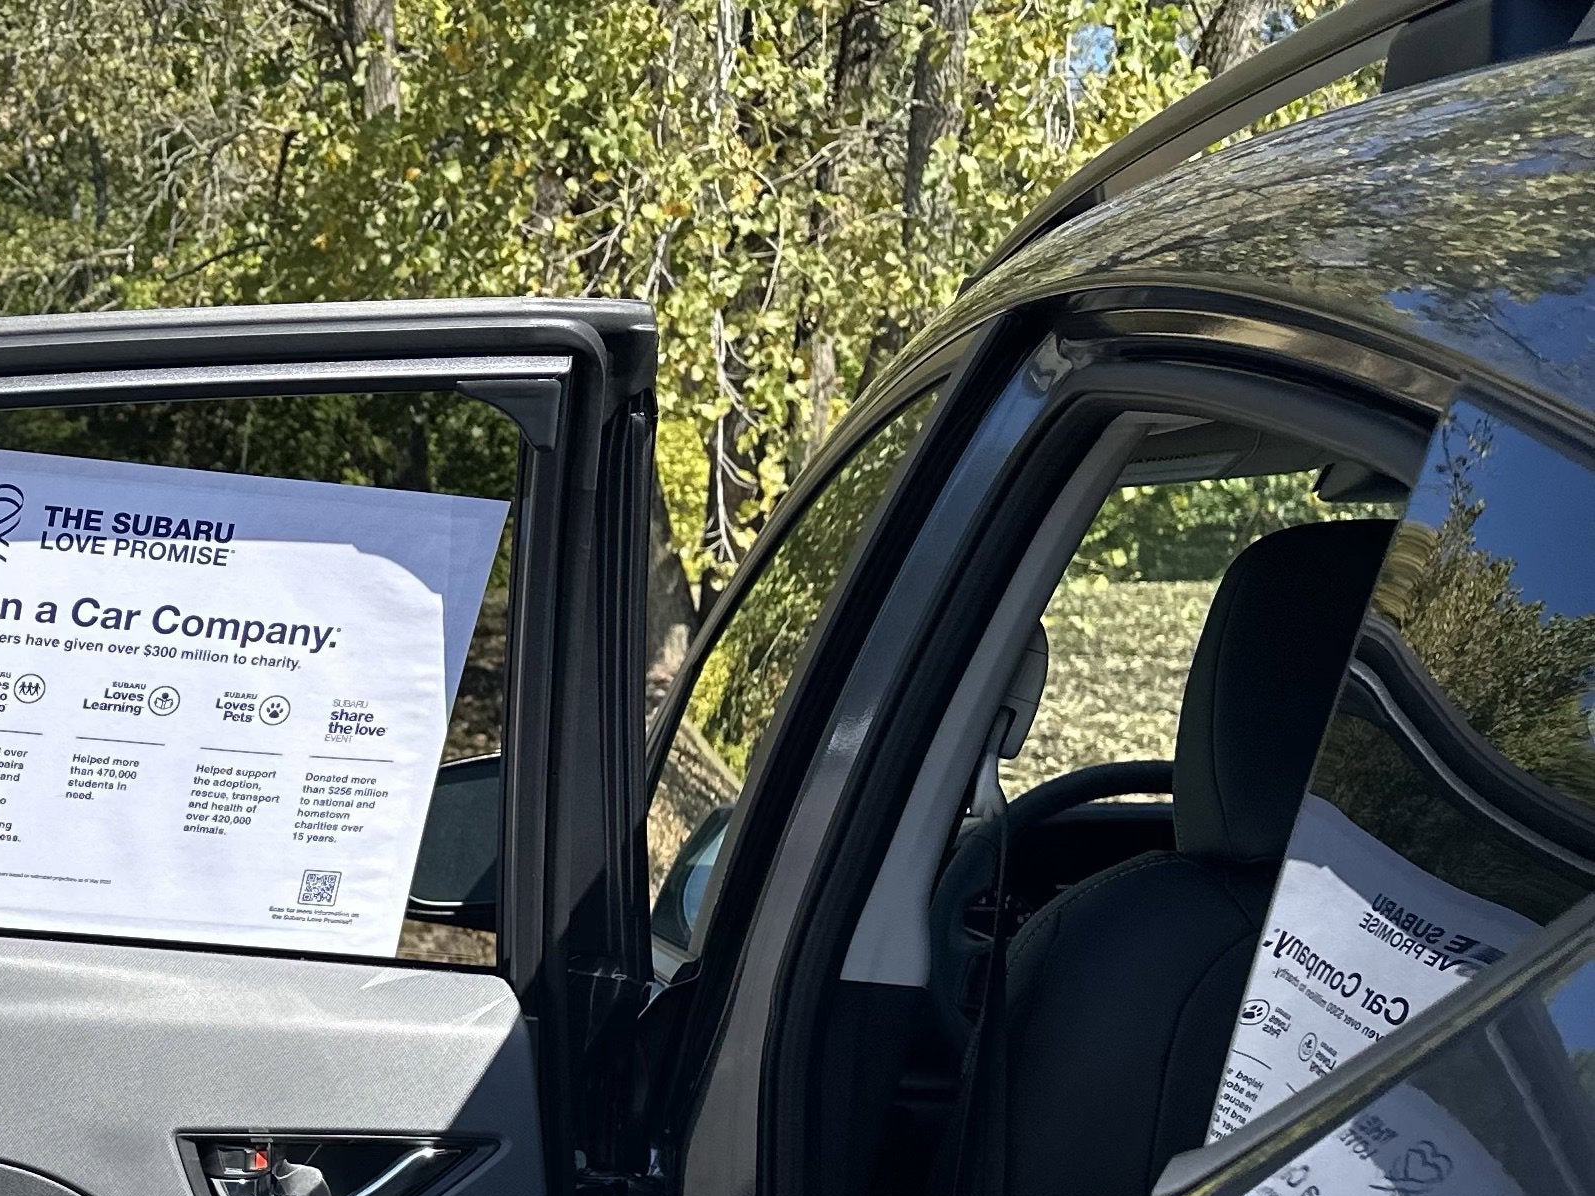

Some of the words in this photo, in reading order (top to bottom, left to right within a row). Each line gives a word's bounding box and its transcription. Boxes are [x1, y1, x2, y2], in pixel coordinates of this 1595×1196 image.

[43, 505, 103, 532] THE
[111, 511, 236, 544] SUBARU
[40, 531, 107, 556] LOVE
[34, 600, 58, 624] a
[70, 596, 142, 631] Car
[24, 632, 61, 648] have
[62, 637, 104, 653] given
[106, 643, 141, 655] over
[142, 643, 178, 659] $300
[179, 648, 229, 664] million
[232, 652, 247, 665] to
[249, 654, 301, 672] charity.
[104, 688, 145, 702] Loves
[215, 698, 255, 712] Loves
[330, 708, 375, 723] share
[328, 721, 354, 735] the
[3, 749, 29, 758] over
[72, 754, 111, 766] Helped
[112, 759, 140, 768] more
[0, 773, 21, 782] and
[70, 766, 94, 777] than
[96, 768, 137, 780] 470,000
[196, 764, 234, 777] Helped
[235, 769, 277, 780] support
[305, 772, 349, 784] Donated
[350, 777, 377, 785] more
[68, 779, 114, 790] students
[117, 781, 127, 791] in
[193, 776, 211, 786] the
[213, 779, 262, 792] adoption,
[66, 791, 94, 800] need.
[190, 790, 229, 801] rescue,
[232, 792, 280, 805] transport
[302, 785, 326, 794] than
[354, 788, 389, 798] million
[188, 801, 209, 810] and
[211, 802, 243, 813] health
[246, 805, 257, 814] of
[300, 797, 311, 806] to
[313, 798, 354, 808] national
[356, 801, 376, 809] and
[186, 813, 210, 822] over
[211, 814, 252, 826] 420,000
[297, 808, 351, 820] hometown
[183, 824, 226, 835] animals.
[294, 820, 339, 831] charities
[341, 825, 364, 833] over
[293, 832, 305, 841] 15
[306, 835, 337, 844] years.
